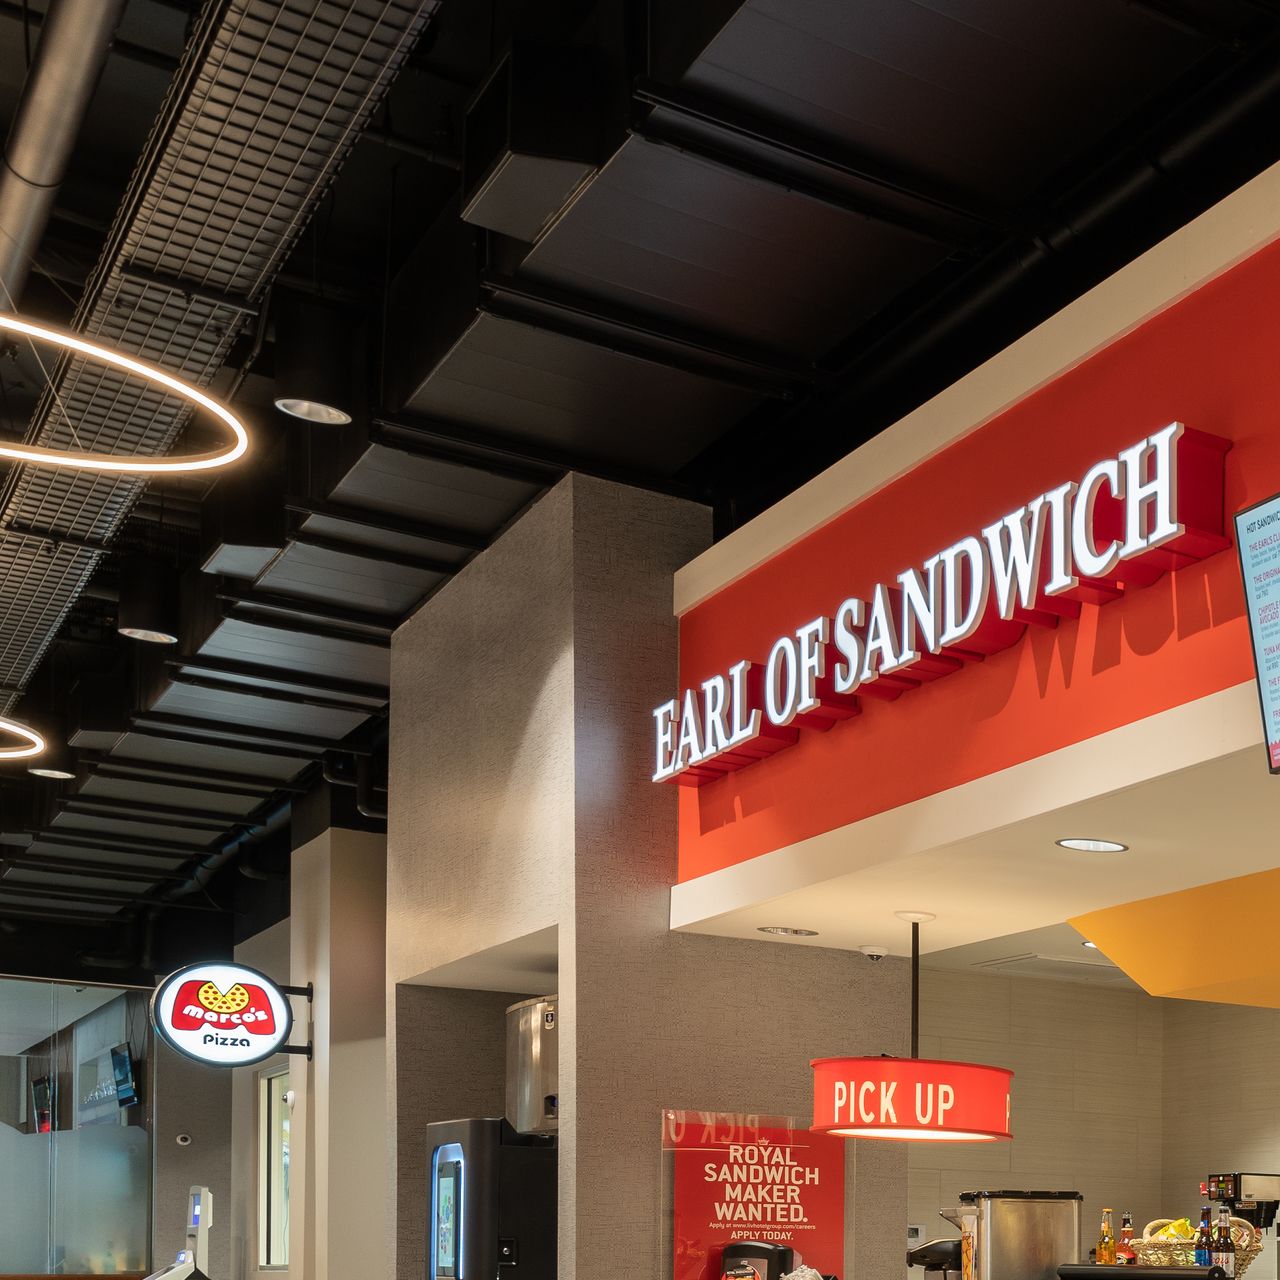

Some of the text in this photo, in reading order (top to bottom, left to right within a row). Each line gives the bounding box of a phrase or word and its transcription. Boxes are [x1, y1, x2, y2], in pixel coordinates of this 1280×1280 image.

[1245, 521, 1257, 535] HOT
[652, 421, 1185, 782] EARL OF SANDWICH
[834, 1081, 898, 1124] PICK
[915, 1083, 955, 1126] UP
[729, 1145, 798, 1166] ROYAL
[704, 1163, 820, 1185] SANDWICH
[725, 1183, 801, 1203] MAKER
[714, 1202, 809, 1222] WANTED.
[730, 1231, 794, 1241] APPLY TODAY.
